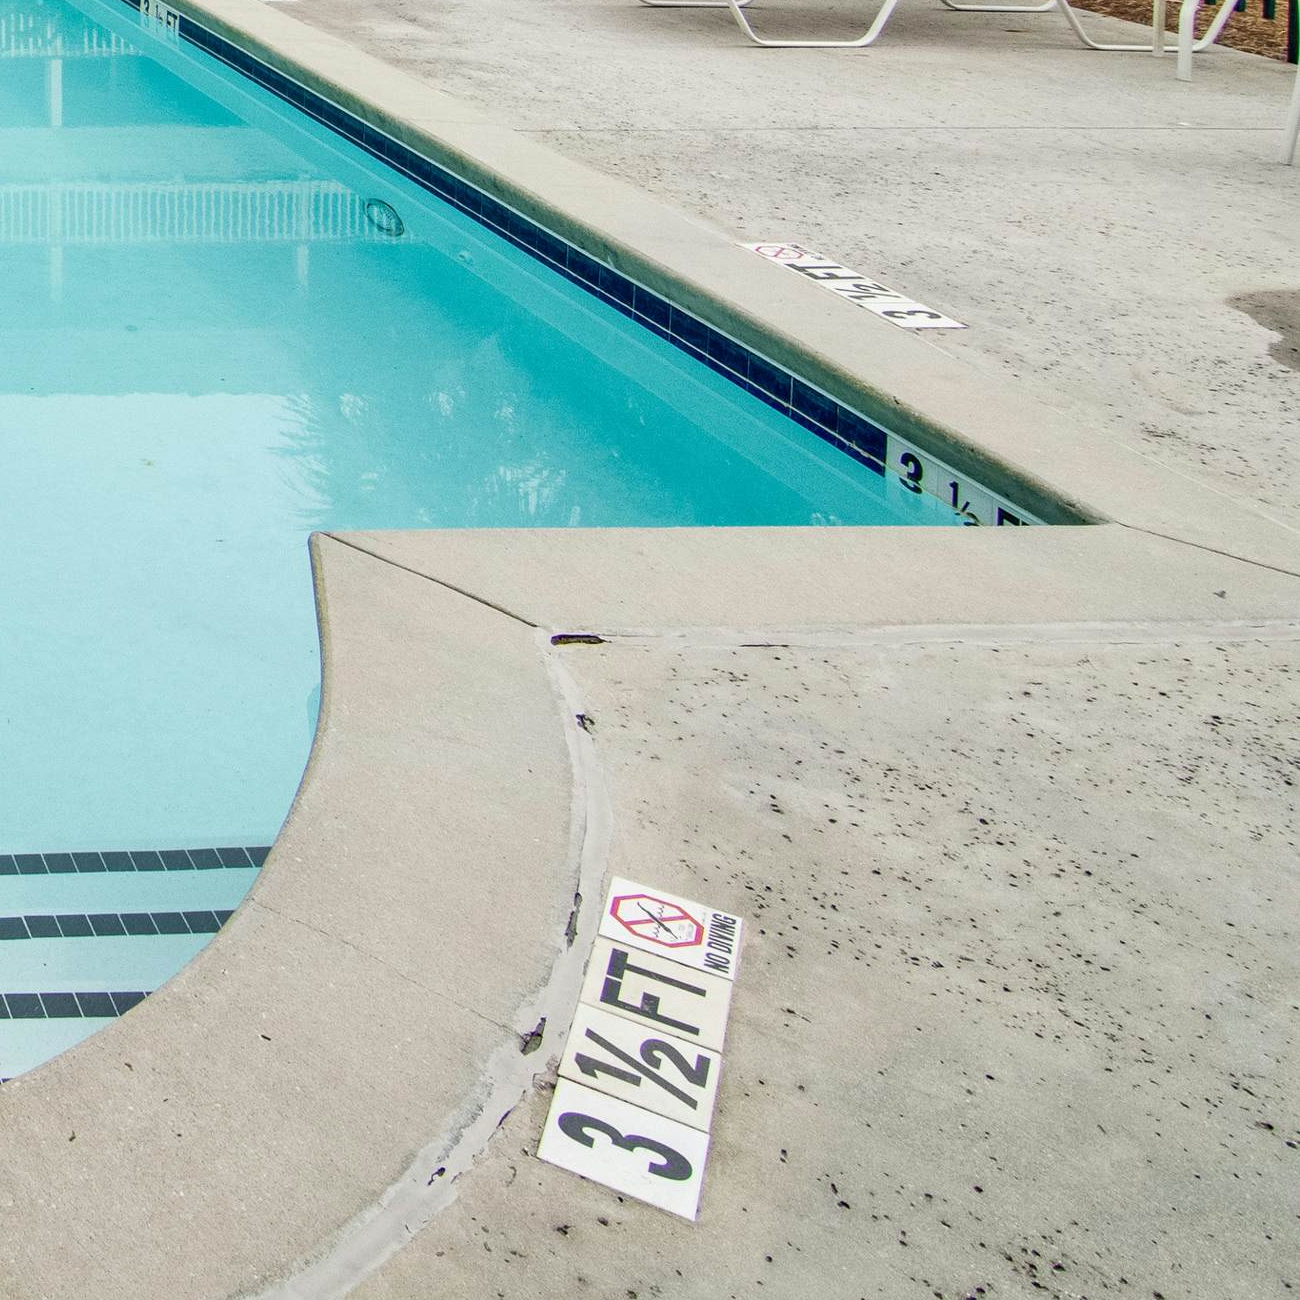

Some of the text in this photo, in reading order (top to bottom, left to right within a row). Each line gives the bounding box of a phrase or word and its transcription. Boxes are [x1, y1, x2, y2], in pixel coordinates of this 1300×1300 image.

[784, 263, 865, 280] FT
[899, 452, 923, 494] 3
[703, 913, 738, 975] NO DIVING
[600, 947, 707, 1036] FT
[558, 1111, 693, 1181] 3
